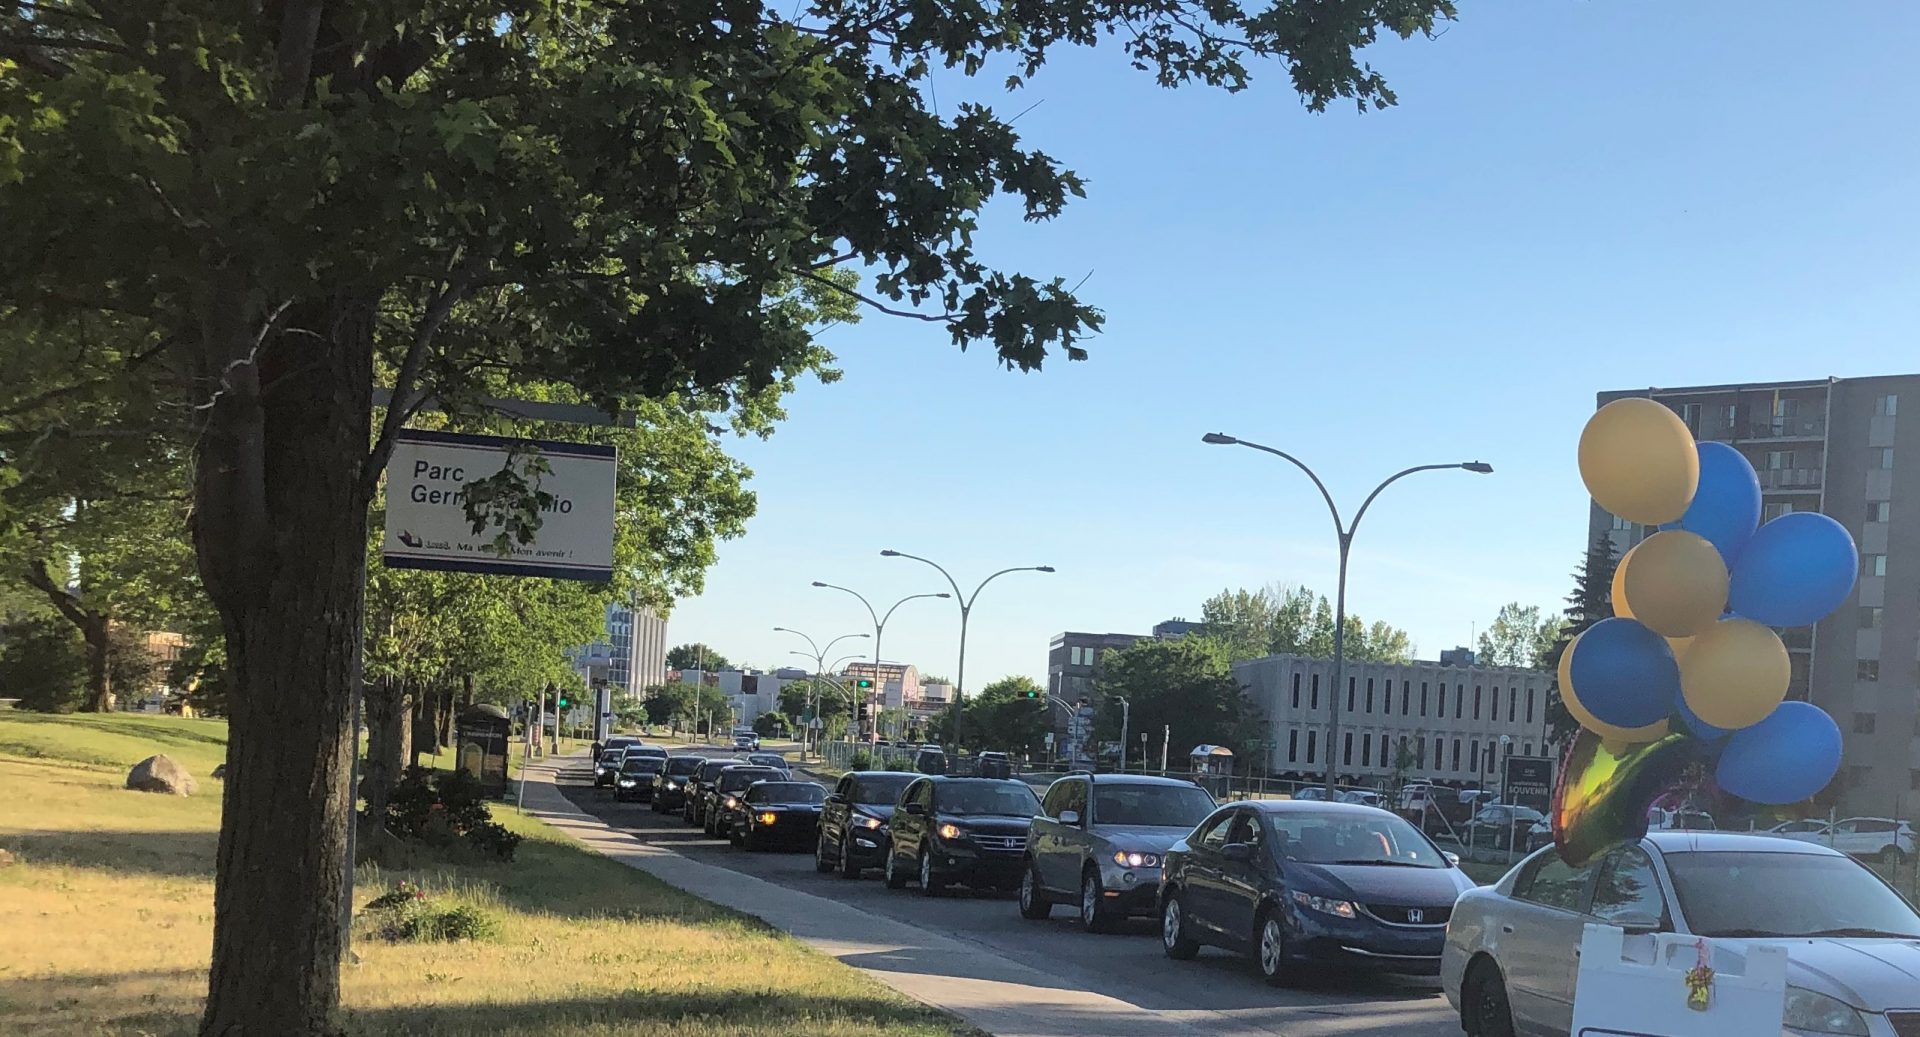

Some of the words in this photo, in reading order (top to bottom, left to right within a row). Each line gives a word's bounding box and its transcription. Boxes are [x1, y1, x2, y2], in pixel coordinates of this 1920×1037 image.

[414, 460, 465, 482] Parc
[457, 543, 473, 553] Ma
[535, 550, 566, 559] avenir
[1508, 786, 1549, 796] SOUVENIR
